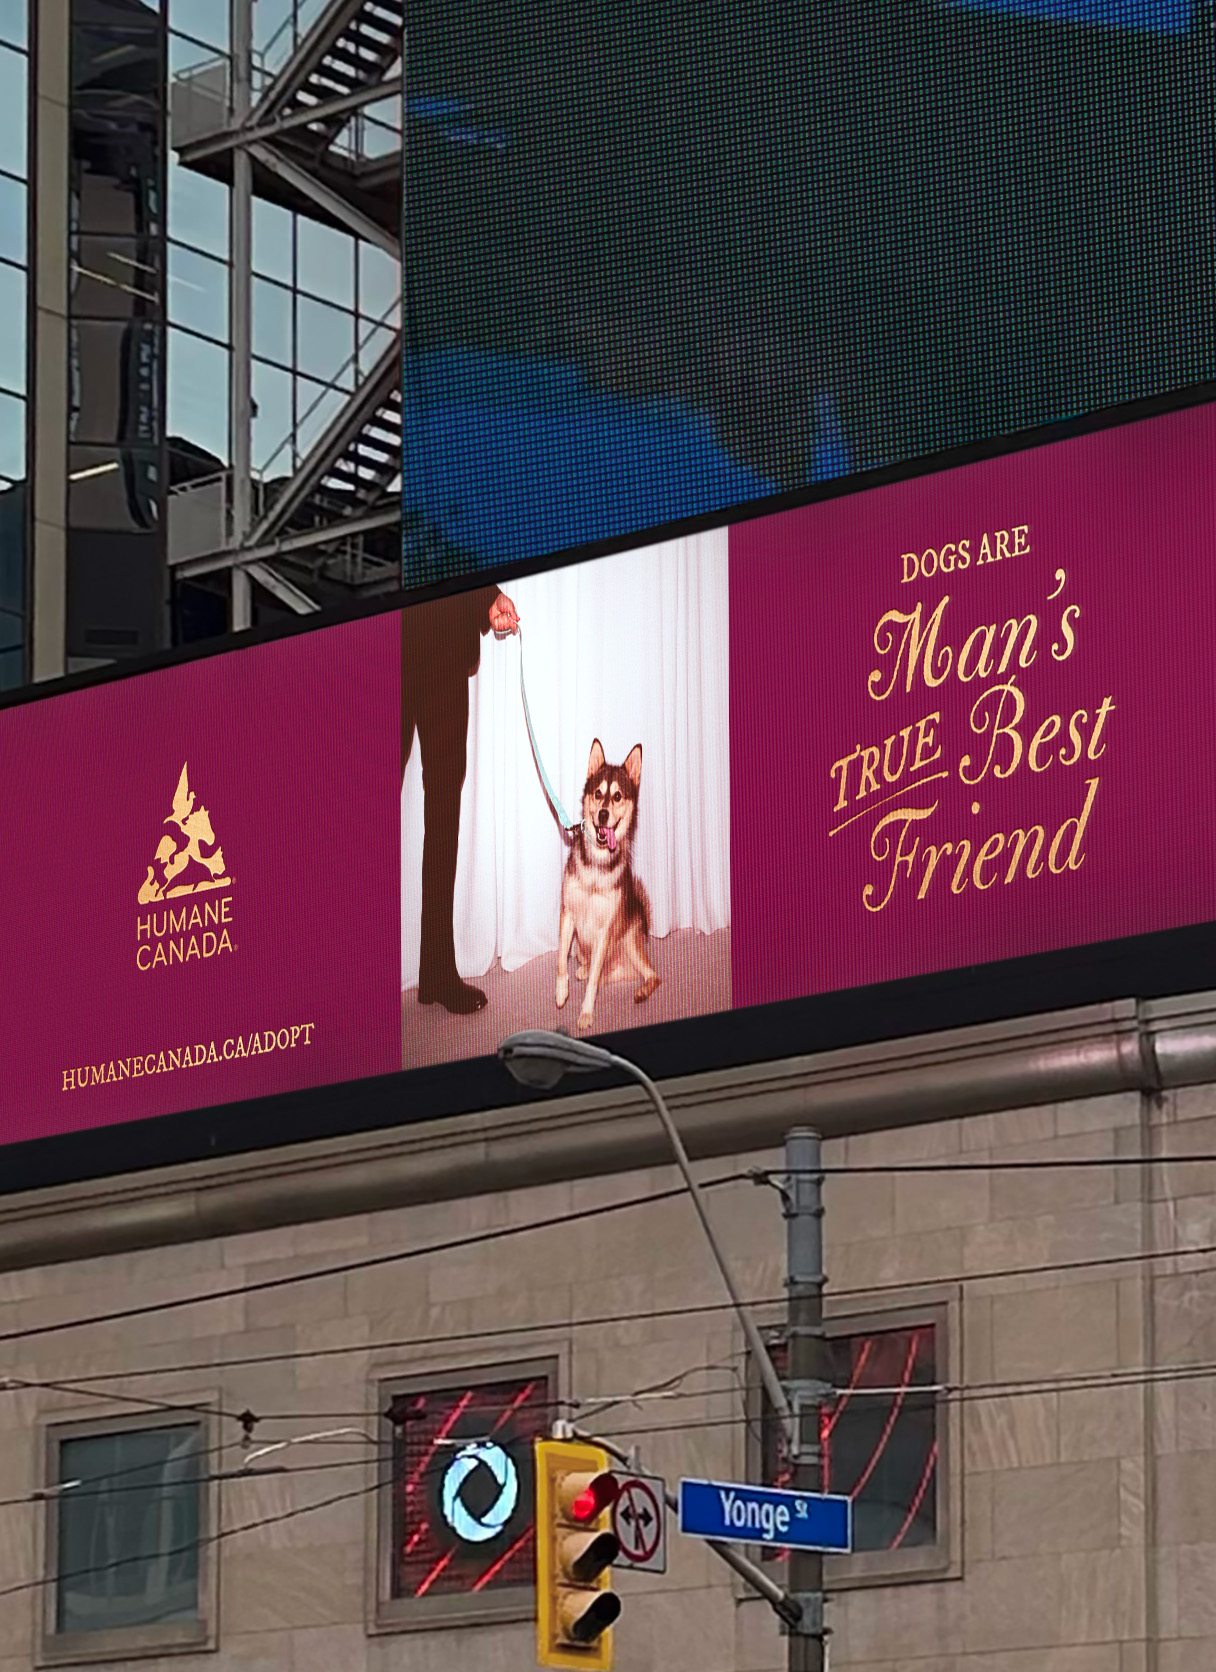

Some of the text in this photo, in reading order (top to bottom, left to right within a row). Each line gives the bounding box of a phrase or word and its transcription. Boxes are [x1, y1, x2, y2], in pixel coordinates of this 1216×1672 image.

[900, 525, 1031, 583] DOGS ARE
[868, 568, 1080, 700] Man's
[830, 675, 1115, 812] TRUE Best
[863, 777, 1100, 912] Friend
[136, 928, 234, 971] CANADA
[137, 896, 234, 941] HUMANE
[61, 1022, 315, 1091] HUMANECANADA.CA/ADOPT
[719, 1489, 790, 1540] Yonge
